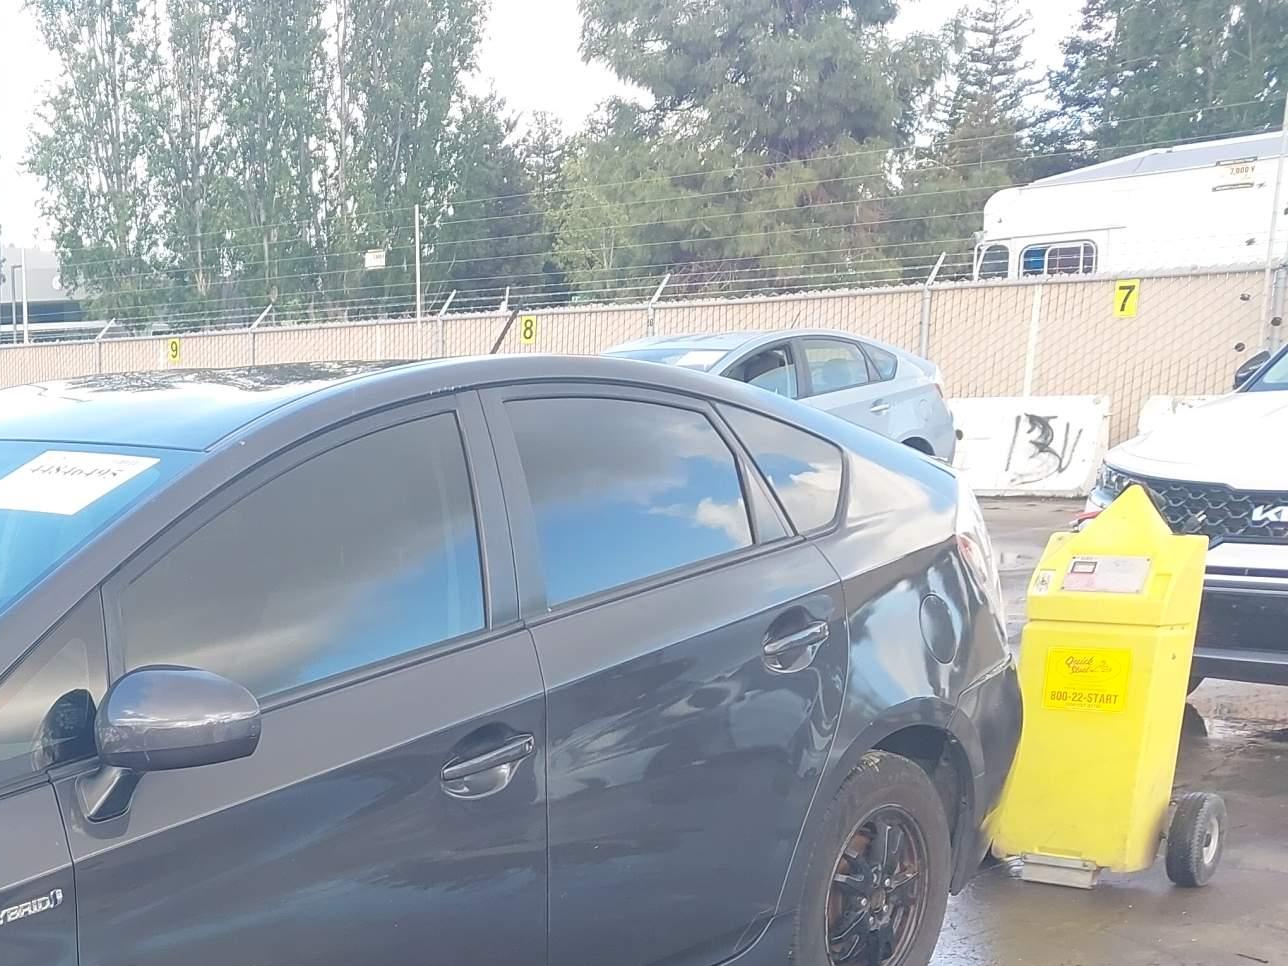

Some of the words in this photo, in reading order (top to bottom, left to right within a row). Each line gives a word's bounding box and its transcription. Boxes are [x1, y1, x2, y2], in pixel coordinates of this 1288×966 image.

[1118, 284, 1136, 312] 7
[523, 318, 534, 340] 8
[170, 341, 179, 359] 9
[1252, 504, 1288, 522] KI
[1050, 690, 1119, 705] 800-22-START
